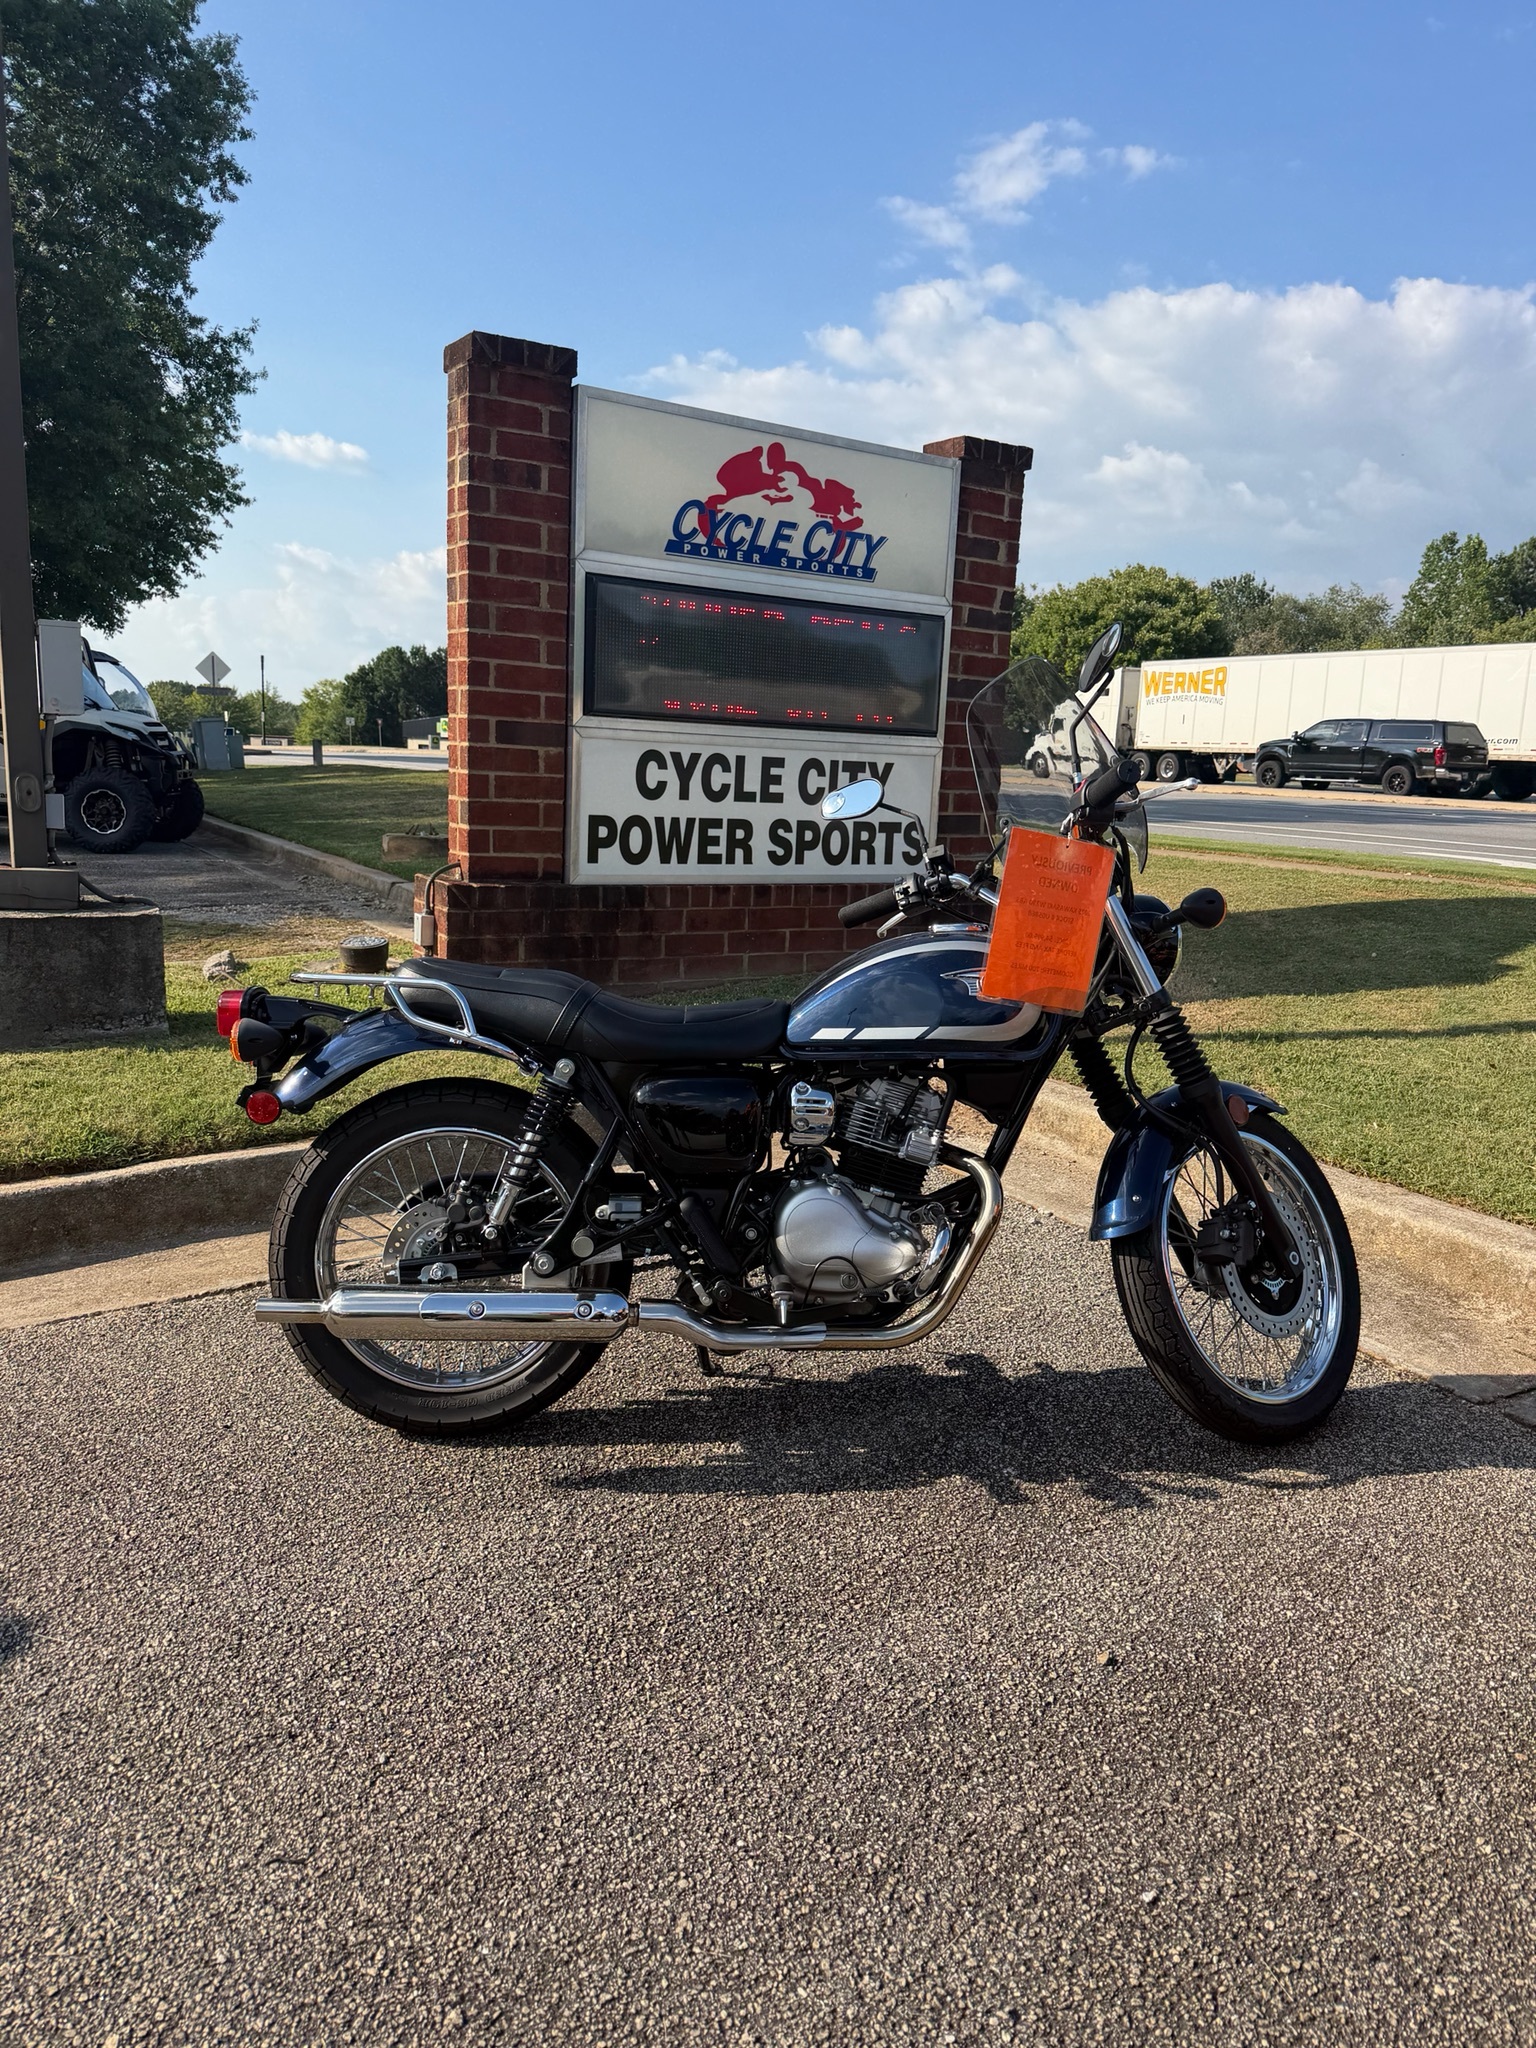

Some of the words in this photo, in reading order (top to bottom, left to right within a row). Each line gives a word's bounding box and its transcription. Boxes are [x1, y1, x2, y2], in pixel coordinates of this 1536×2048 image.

[671, 499, 799, 556] CYCLE
[802, 519, 889, 567] CITY
[683, 543, 761, 564] POWER
[780, 557, 865, 578] SPORTS
[1143, 666, 1228, 698] WERNER
[1146, 698, 1155, 706] WE
[1156, 695, 1171, 704] KEEP
[1171, 694, 1198, 703] AMERICA
[1199, 695, 1224, 706] MOVING
[635, 749, 786, 804] CYCLE
[798, 757, 895, 806] CITY
[587, 814, 754, 866] POWER
[767, 818, 925, 867] SPORTS
